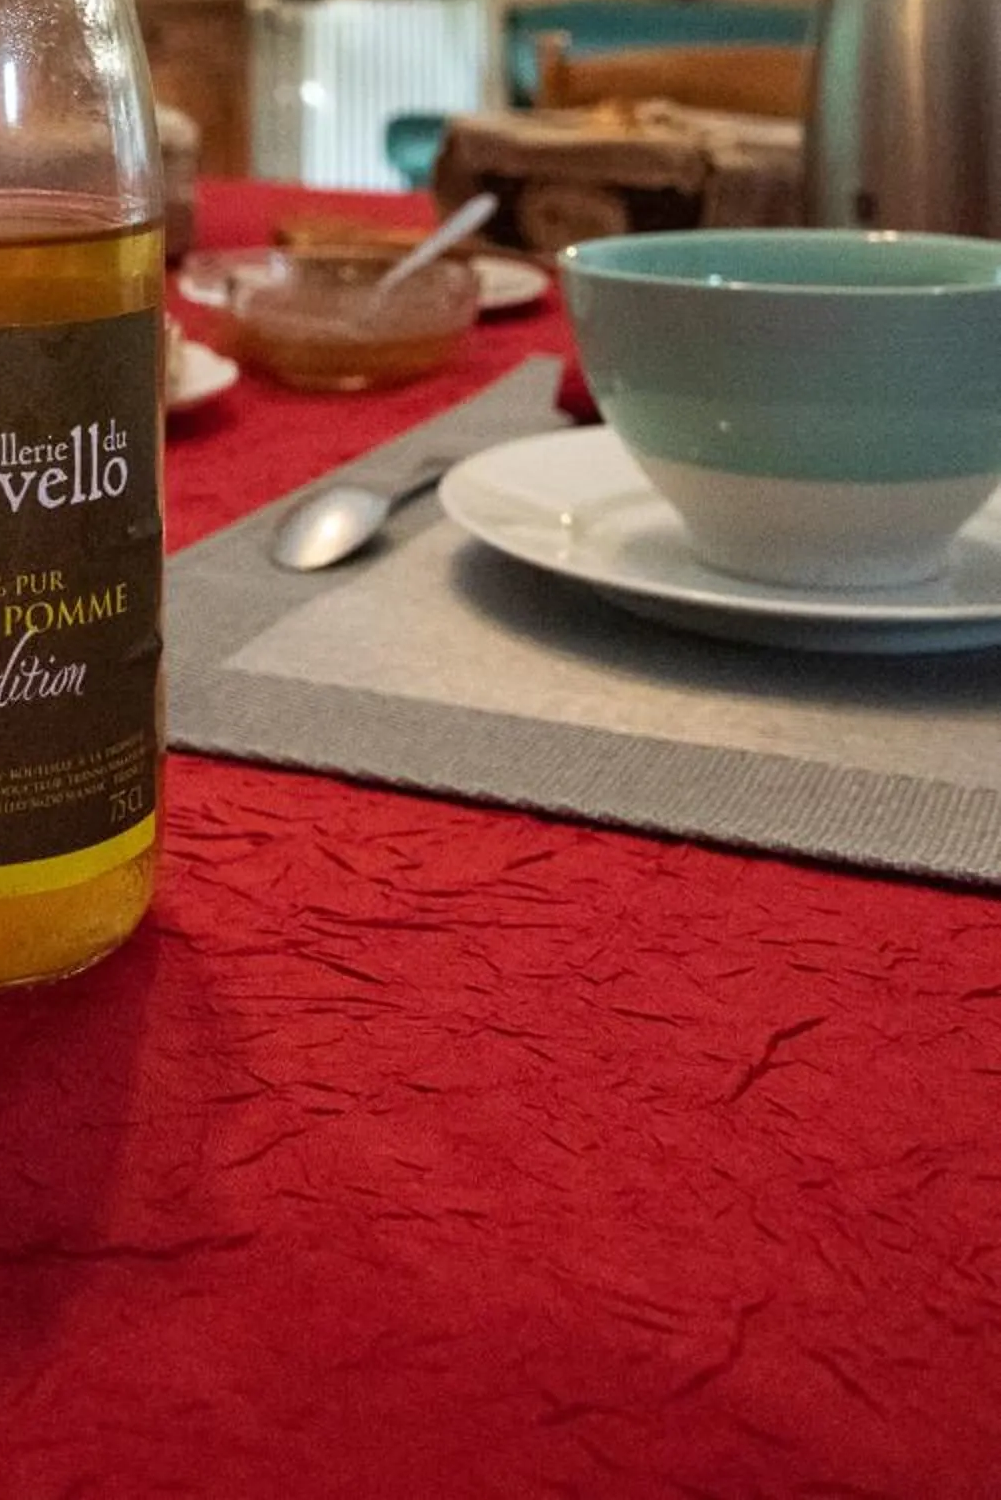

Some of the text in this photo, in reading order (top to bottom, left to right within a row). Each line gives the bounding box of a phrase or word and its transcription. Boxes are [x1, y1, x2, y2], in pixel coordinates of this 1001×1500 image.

[103, 418, 127, 450] du
[16, 569, 67, 595] PUR
[3, 582, 128, 636] POMME
